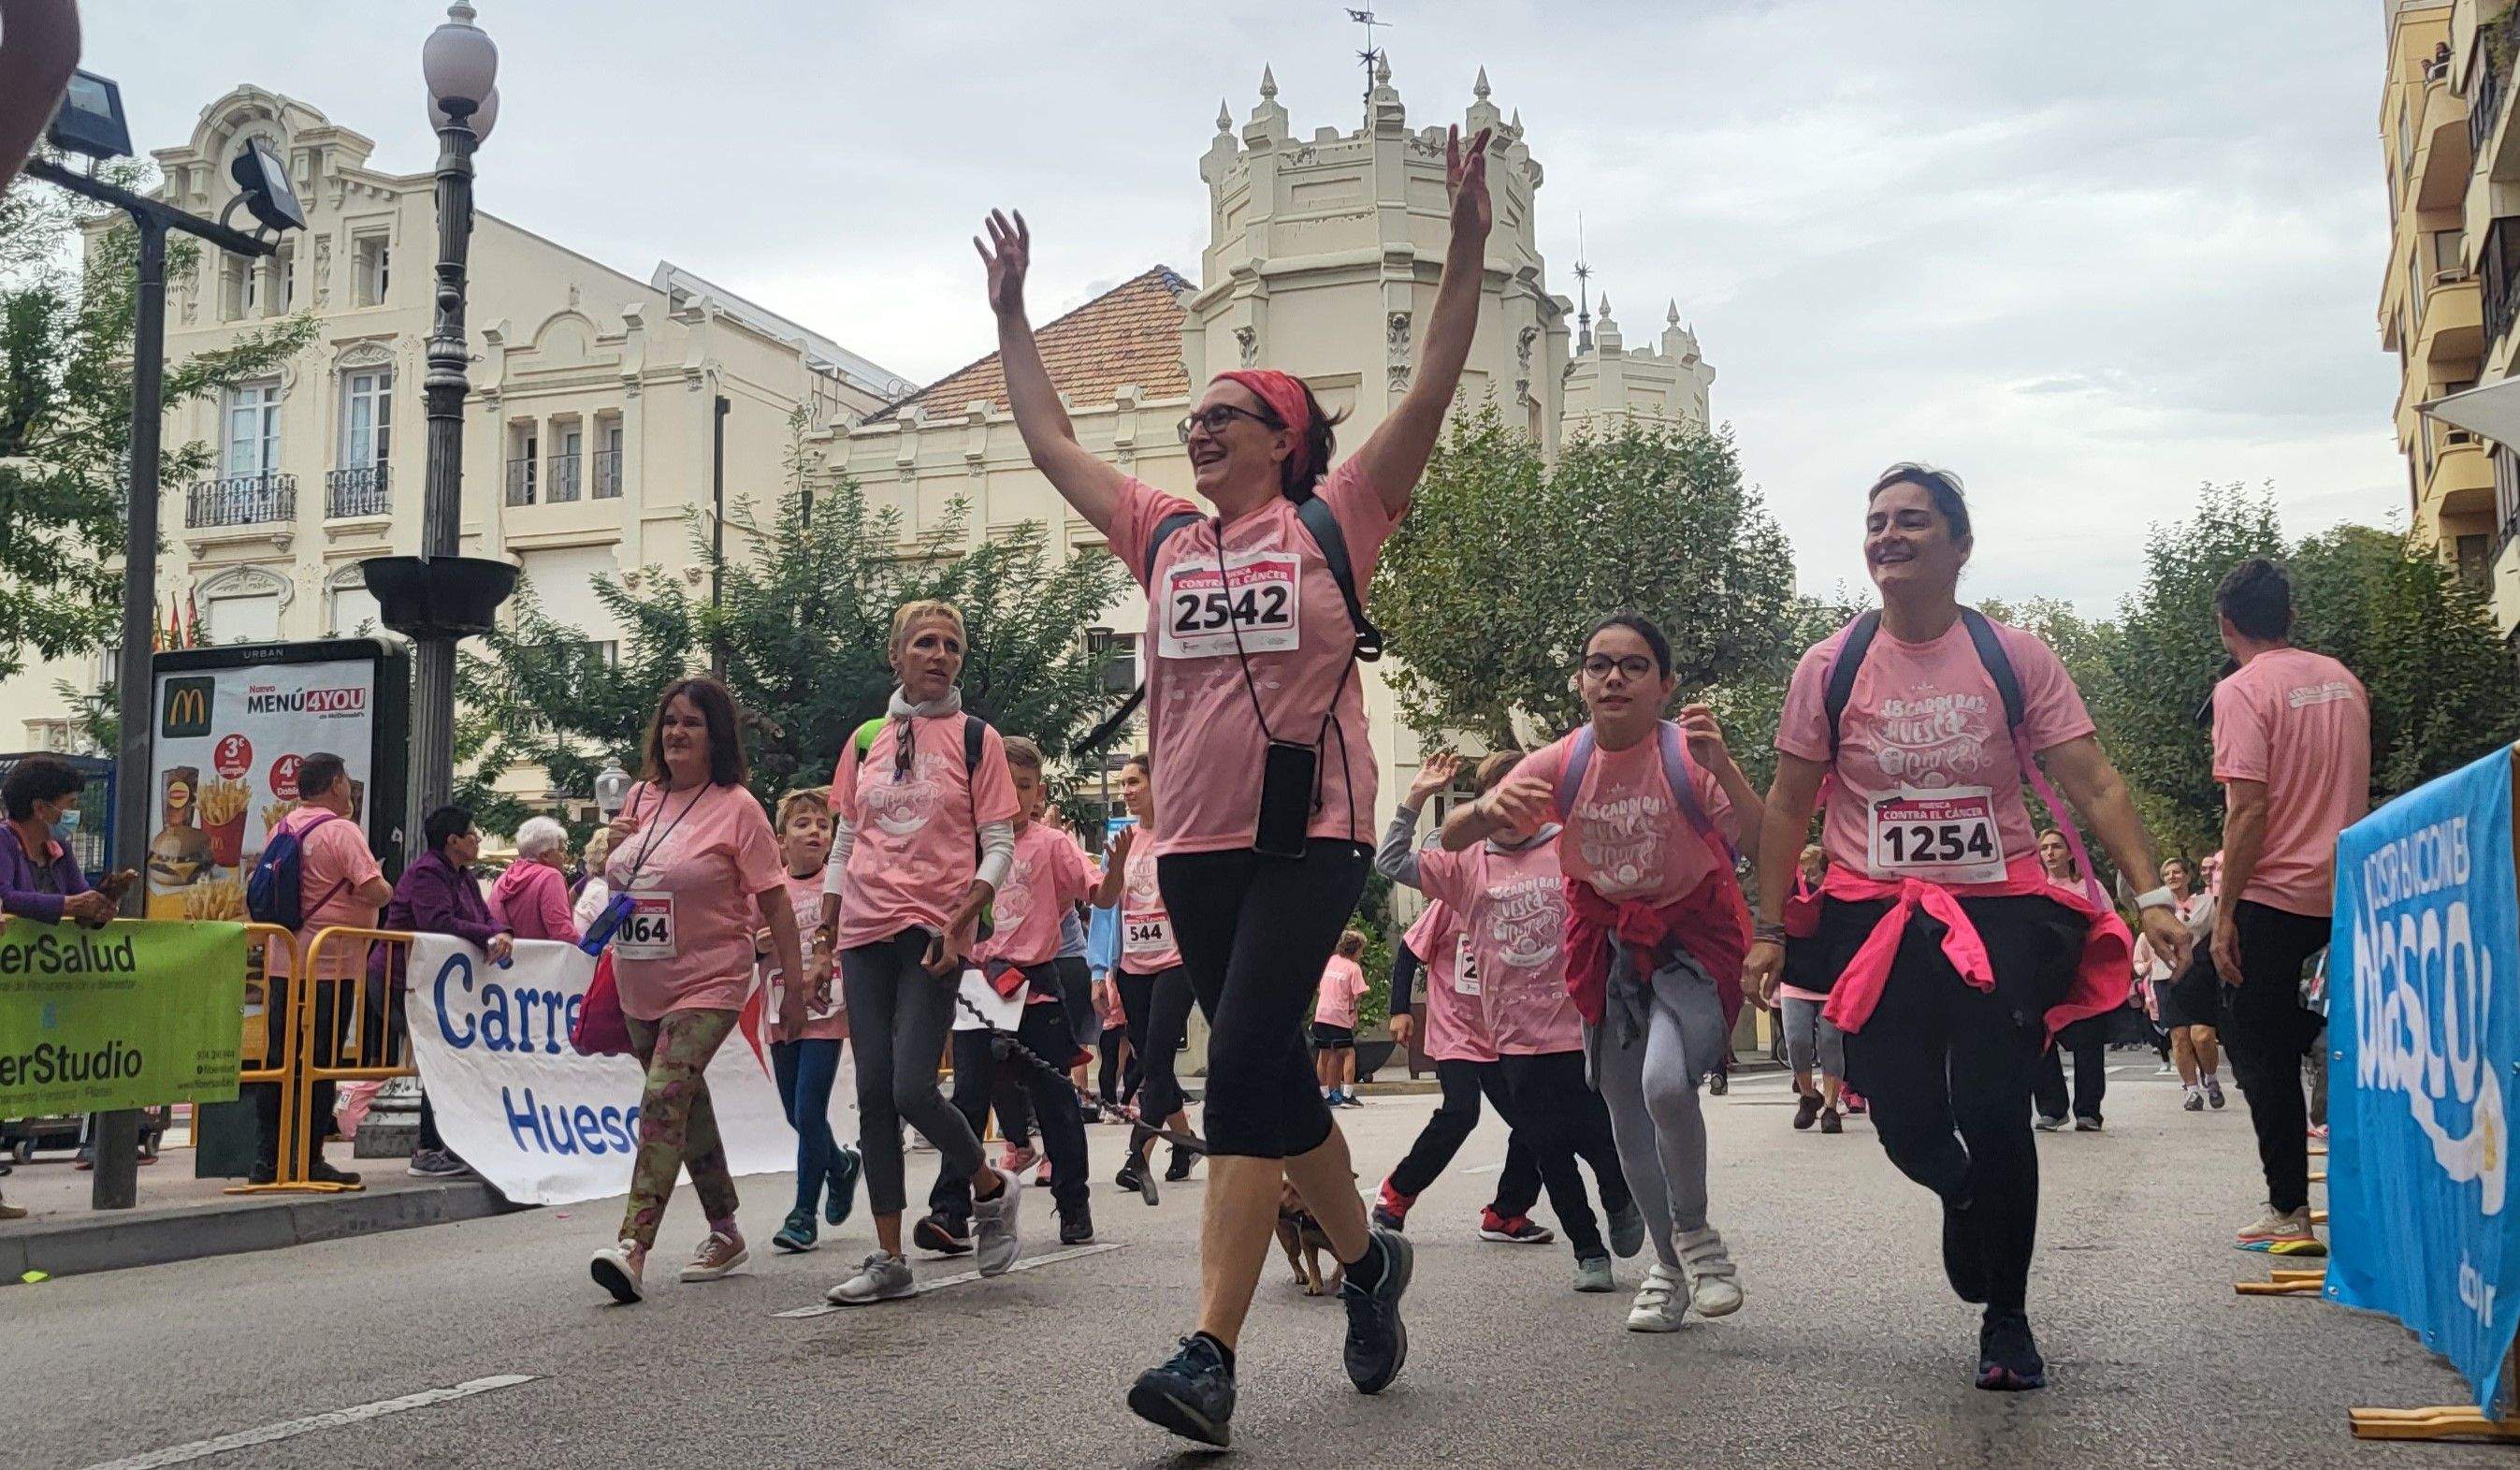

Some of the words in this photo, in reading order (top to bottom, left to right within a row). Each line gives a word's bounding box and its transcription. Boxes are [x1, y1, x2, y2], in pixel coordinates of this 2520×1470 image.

[1175, 585, 1289, 632] 2542
[243, 648, 284, 660] URBAN
[248, 687, 305, 714] MENÚ
[1883, 810, 1928, 821] CONTRA
[1883, 822, 1993, 862] 1254
[1130, 924, 1163, 941] 544
